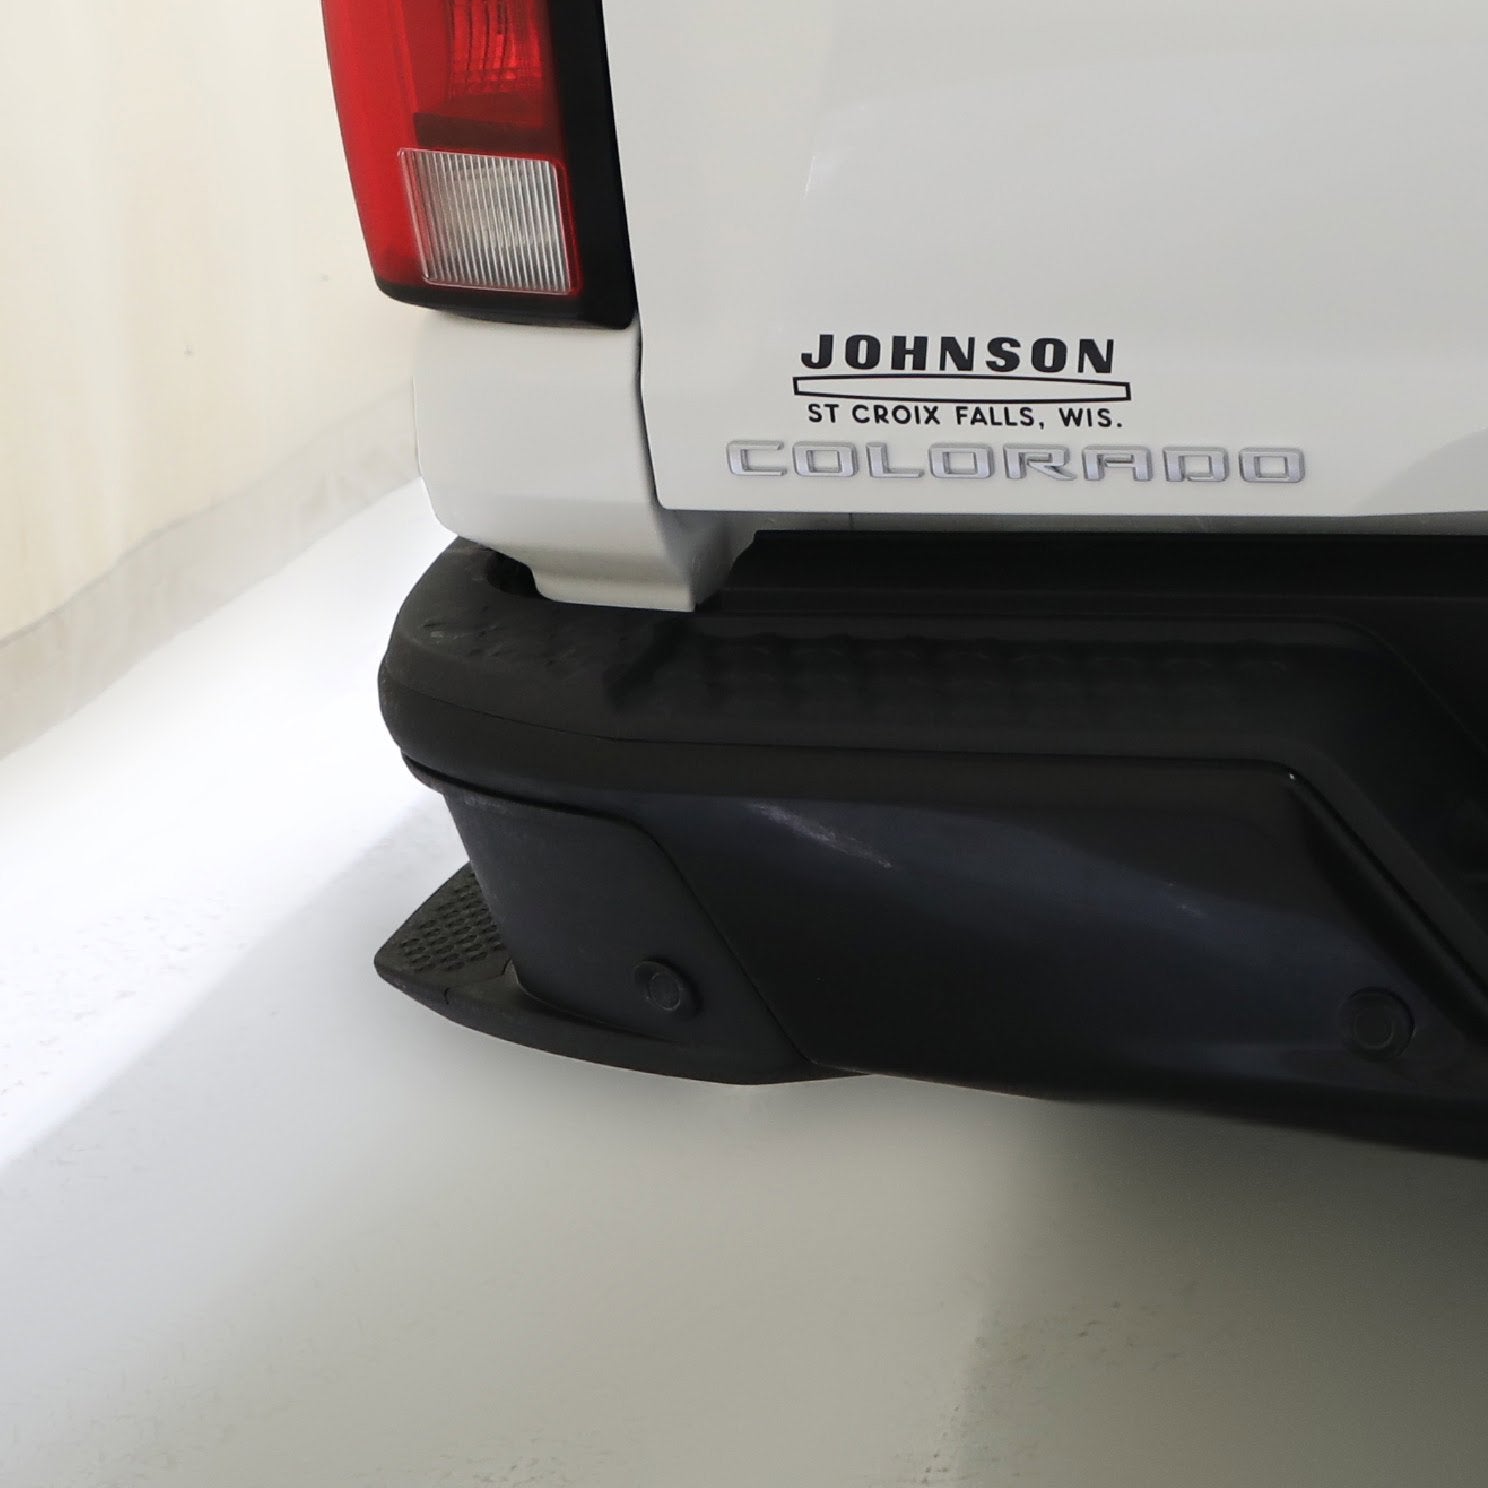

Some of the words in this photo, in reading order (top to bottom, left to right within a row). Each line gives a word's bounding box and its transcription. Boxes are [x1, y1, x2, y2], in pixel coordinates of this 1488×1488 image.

[801, 333, 1115, 374] JOHNSON
[807, 403, 840, 424] ST
[851, 404, 941, 426] CROIX
[954, 405, 1046, 430] FALLS,
[1058, 407, 1123, 429] WIS.
[725, 439, 1307, 484] COLORADO
